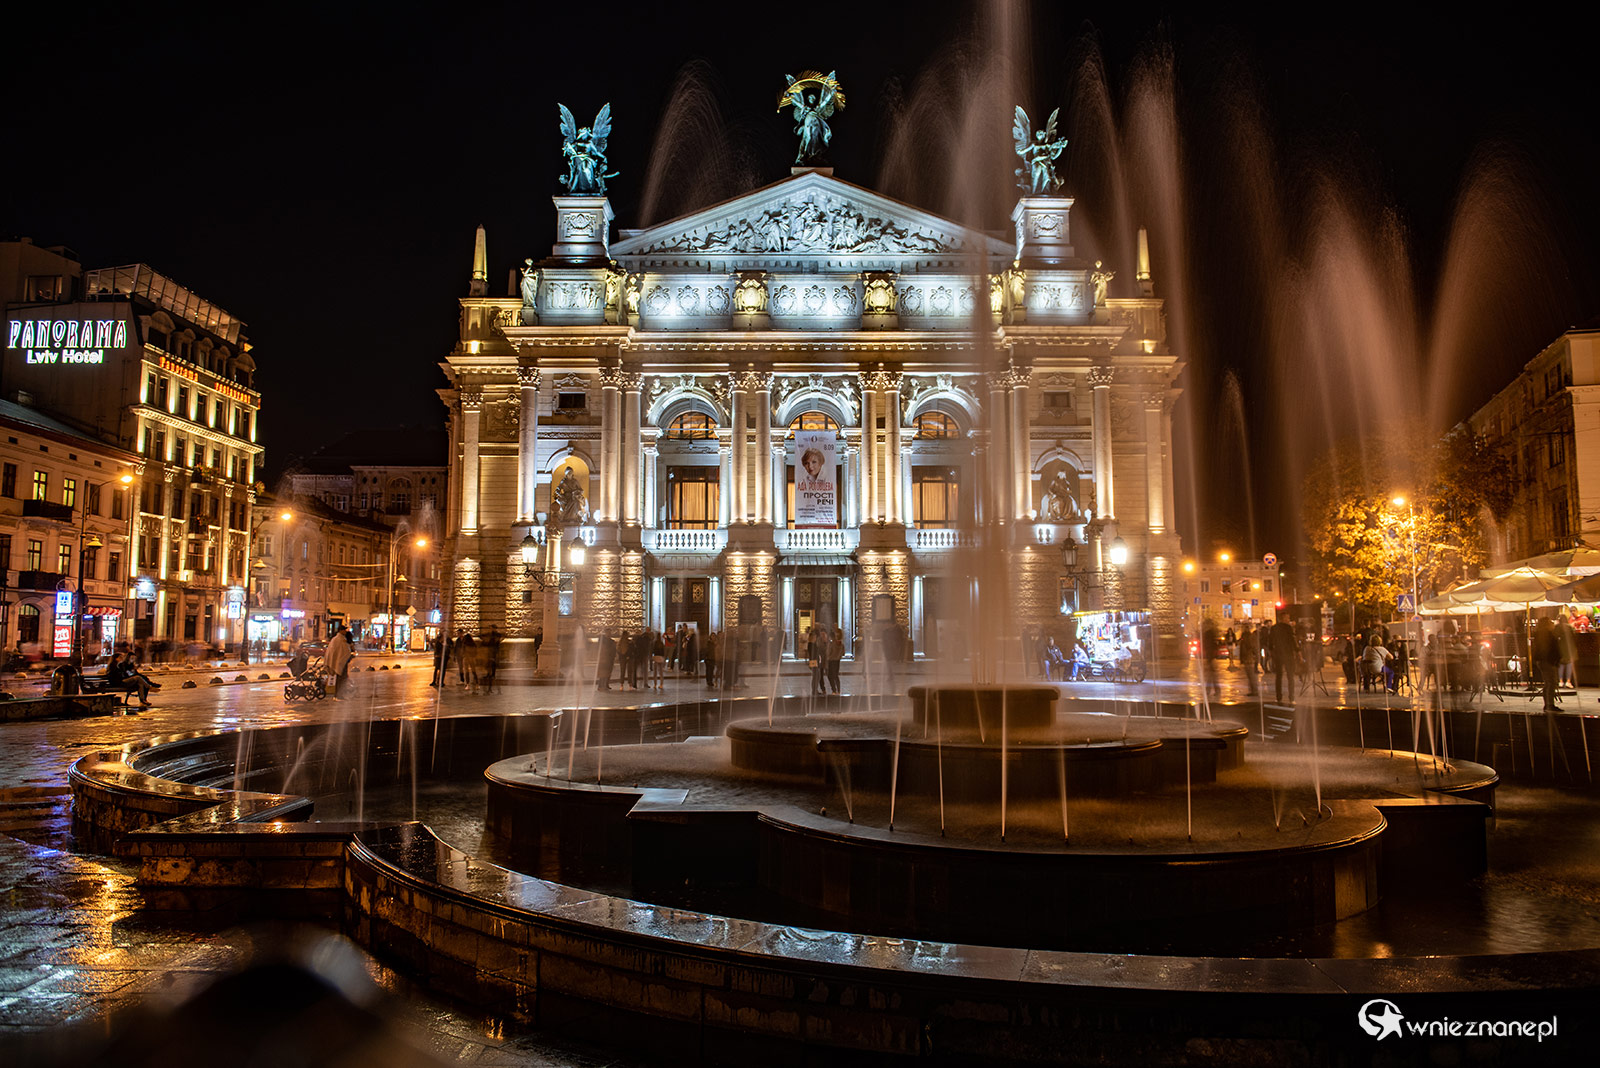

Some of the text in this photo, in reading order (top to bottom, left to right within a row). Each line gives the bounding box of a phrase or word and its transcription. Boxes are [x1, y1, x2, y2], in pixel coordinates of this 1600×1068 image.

[7, 320, 127, 348] PANORAMA
[27, 349, 104, 364] Lviv Hotel
